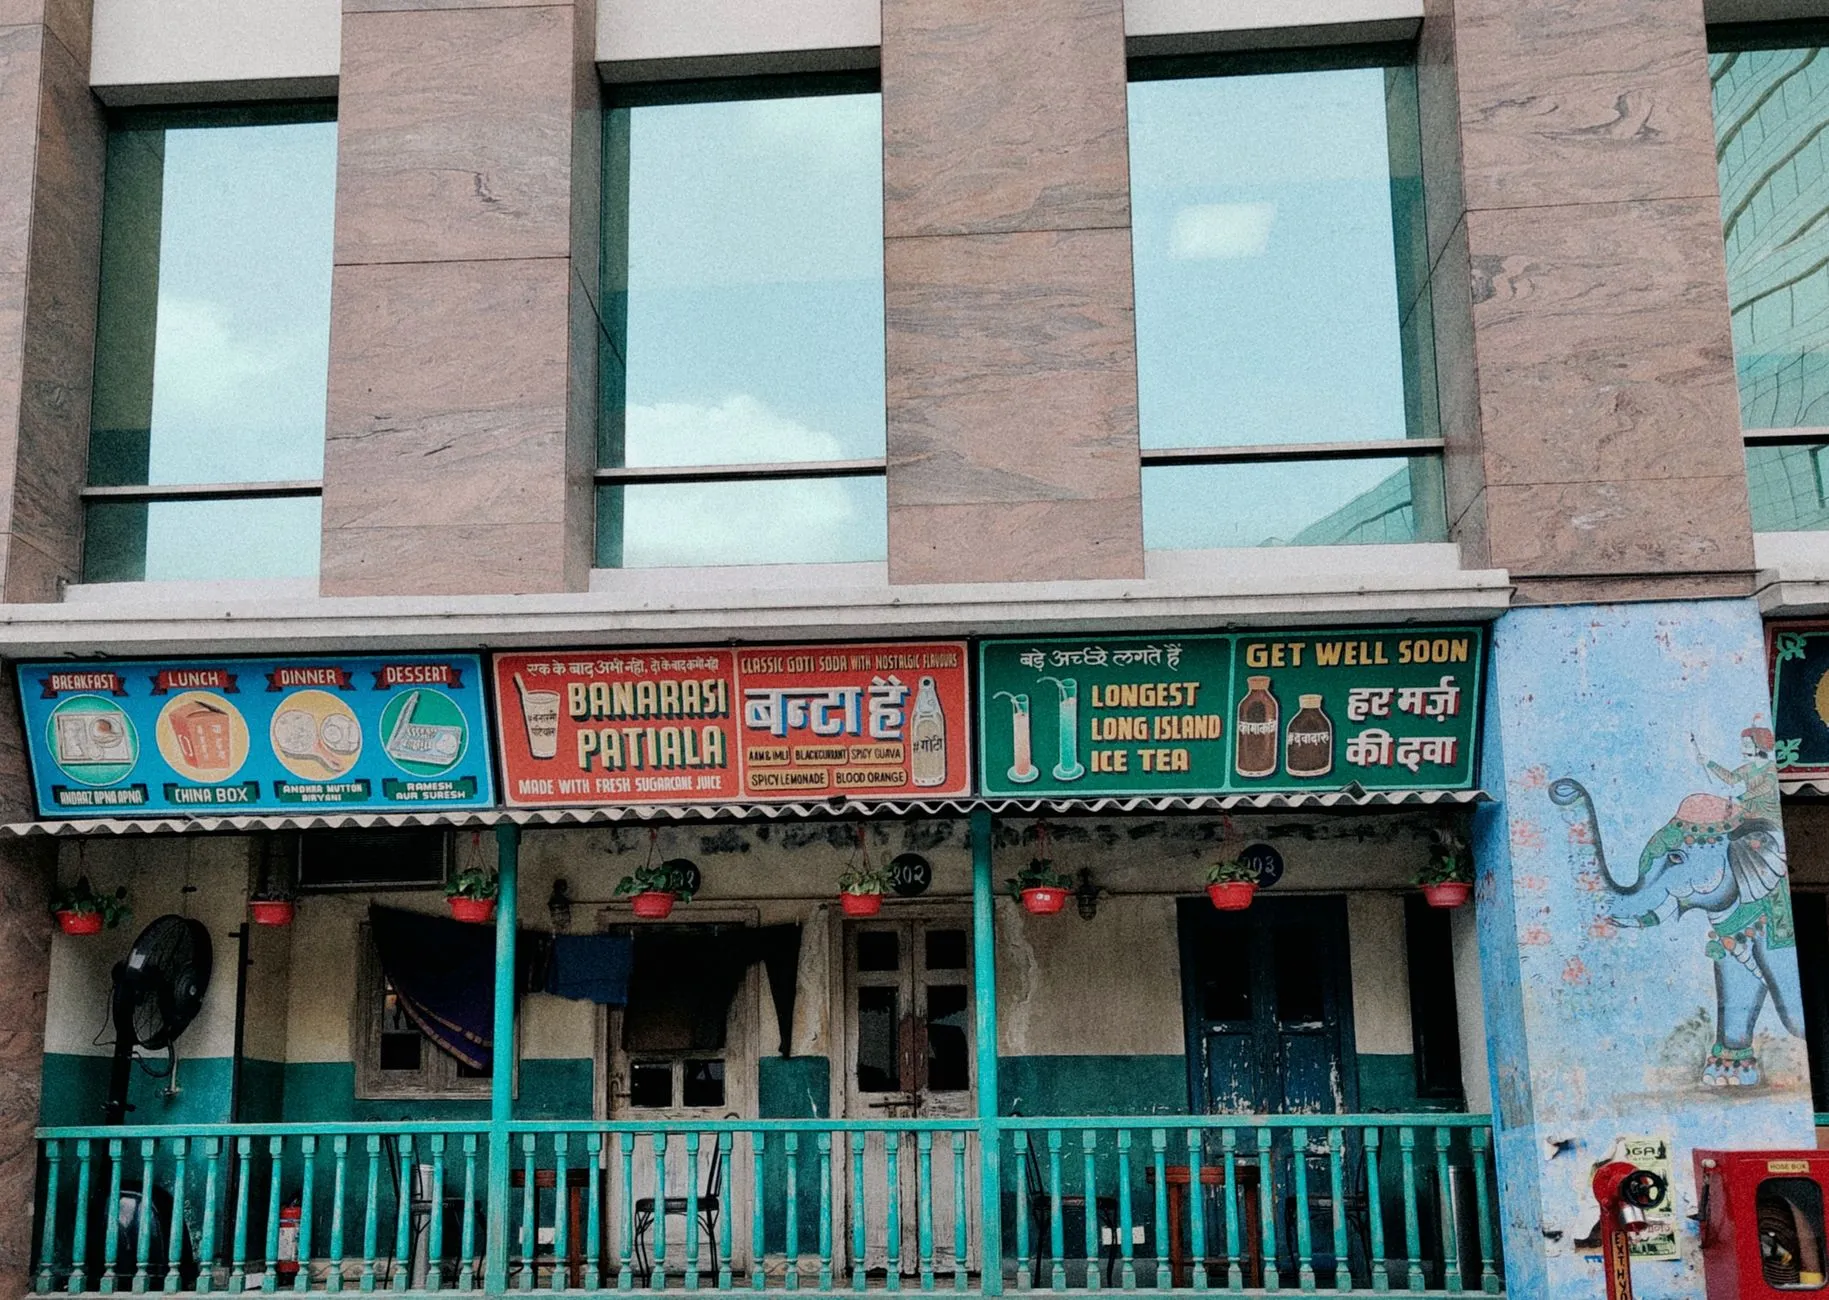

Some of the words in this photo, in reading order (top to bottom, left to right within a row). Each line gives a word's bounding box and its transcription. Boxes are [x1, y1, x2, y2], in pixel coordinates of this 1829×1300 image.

[1020, 648, 1047, 672] बड़े
[1049, 646, 1109, 667] अच्छे
[1113, 644, 1163, 667] लगते
[1164, 643, 1184, 672] हैं
[1246, 642, 1306, 669] GET
[1315, 641, 1389, 667] WELL
[1399, 639, 1469, 664] SOON
[526, 663, 550, 677] एक
[552, 659, 566, 676] के
[568, 662, 595, 678] बाद
[594, 657, 624, 674] अभी
[741, 656, 784, 674] CLASSIC
[787, 656, 815, 674] GOTI
[819, 655, 848, 672] SODA
[850, 655, 872, 671] WITH
[876, 653, 921, 670] NOSTALGIC
[922, 652, 958, 669] FLAVOURS
[52, 674, 115, 690] BREAKFAST
[168, 671, 220, 688] LUNCH
[281, 668, 337, 685] DINNER
[386, 666, 448, 683] DESSERT
[567, 679, 728, 719] BANARASI
[1091, 682, 1200, 708] LONGEST
[1347, 687, 1395, 722] हर
[1398, 675, 1461, 722] मर्ज़
[1091, 717, 1149, 741] LONG
[1154, 715, 1222, 741] ISLAND
[577, 725, 727, 770] PATIALA
[749, 750, 765, 761] AAM
[851, 749, 872, 760] SPICY
[875, 748, 901, 760] GUAVA
[1346, 728, 1395, 766] की
[1397, 736, 1459, 772] दवा
[1091, 750, 1129, 773] ICE
[1138, 748, 1190, 773] TEA
[519, 779, 554, 795] MADE
[559, 778, 590, 794] WITH
[596, 777, 631, 792] FRESH
[635, 776, 692, 792] SUGARCANE
[696, 776, 722, 790] JUICE
[751, 774, 779, 787] SPICY
[780, 773, 825, 786] LEMONADE
[836, 772, 865, 784] BLOOD
[867, 771, 904, 783] ORANGE
[175, 788, 213, 803] CHINA
[216, 787, 249, 802] BOX
[326, 783, 362, 793] MUTTON
[407, 782, 453, 791] RAMESH
[302, 793, 342, 802] BIRYANI
[396, 791, 420, 800] AUR
[422, 791, 466, 800] SURESH
